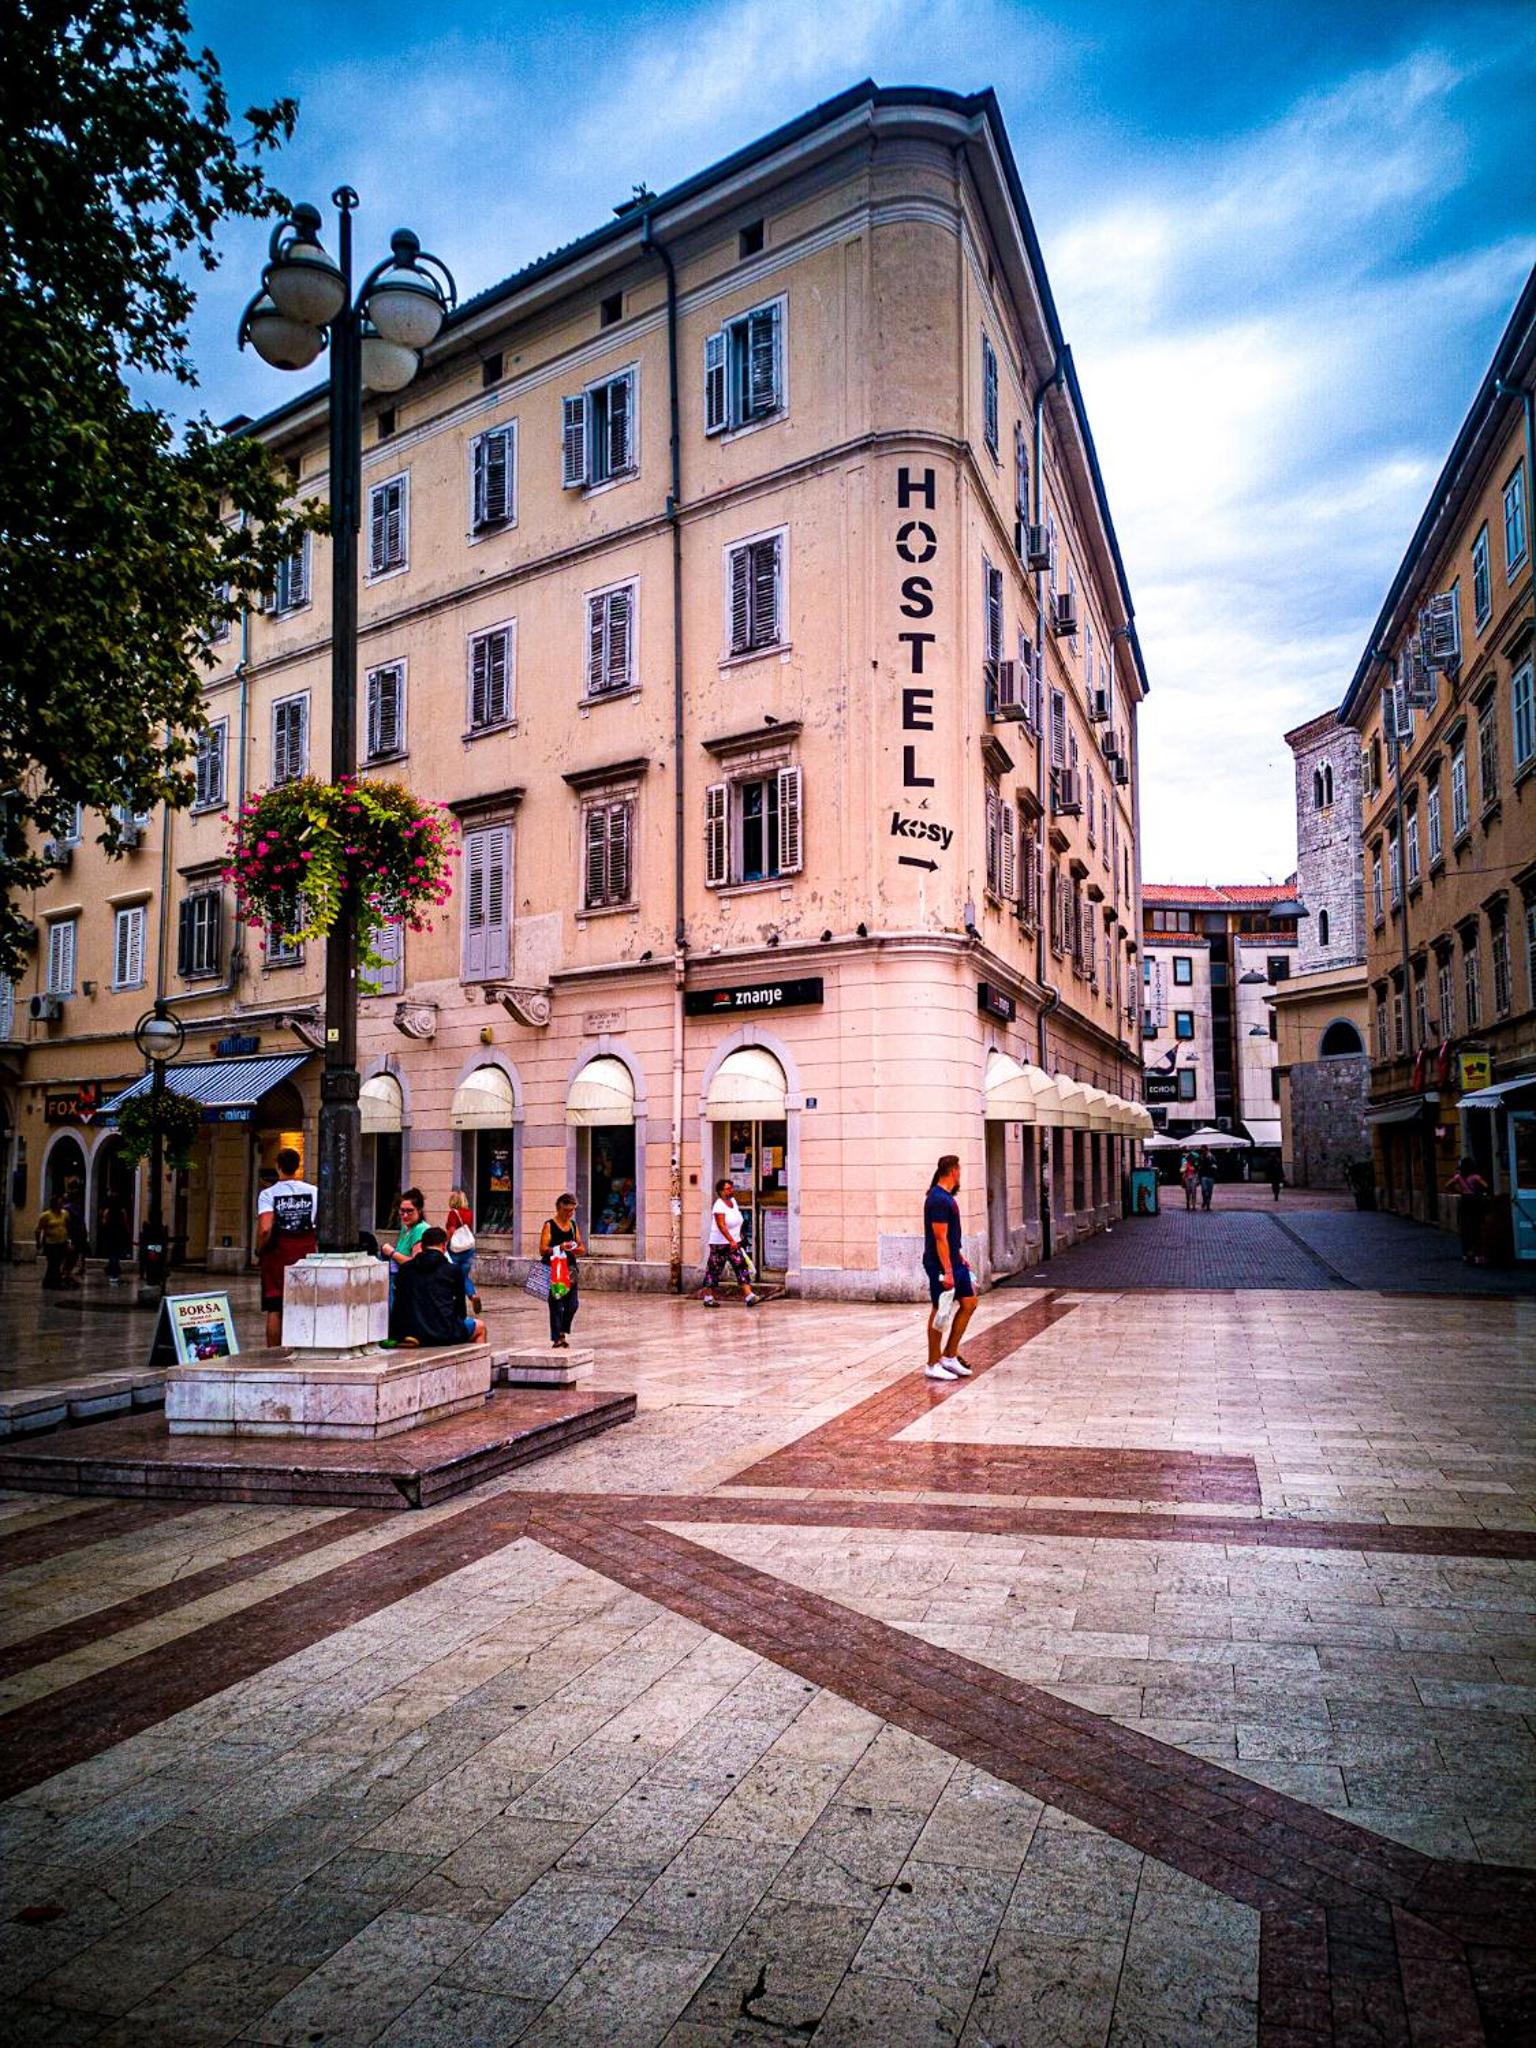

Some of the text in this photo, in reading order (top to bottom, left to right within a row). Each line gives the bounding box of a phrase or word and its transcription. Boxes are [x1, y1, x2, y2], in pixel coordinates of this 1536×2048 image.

[896, 467, 938, 787] HOSTEL
[890, 812, 954, 850] kosy
[735, 986, 783, 1008] znanje
[48, 1101, 78, 1116] FOX
